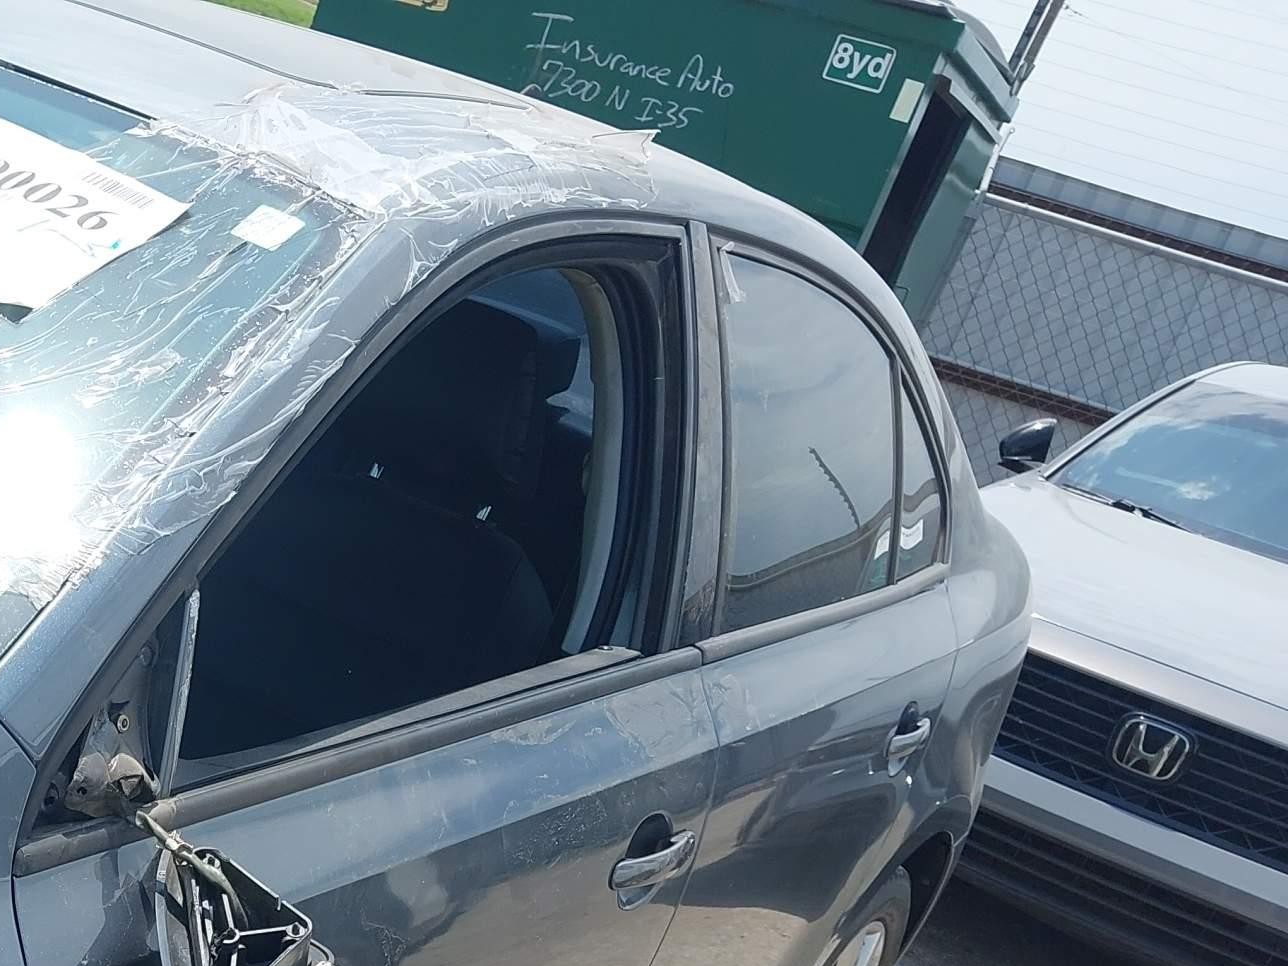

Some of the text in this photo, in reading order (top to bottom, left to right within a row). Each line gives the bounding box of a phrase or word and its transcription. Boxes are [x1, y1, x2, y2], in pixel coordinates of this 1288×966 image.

[526, 12, 734, 98] Insurance Auto
[831, 42, 893, 79] 8yd
[542, 60, 601, 98] 7300
[605, 85, 630, 110] N
